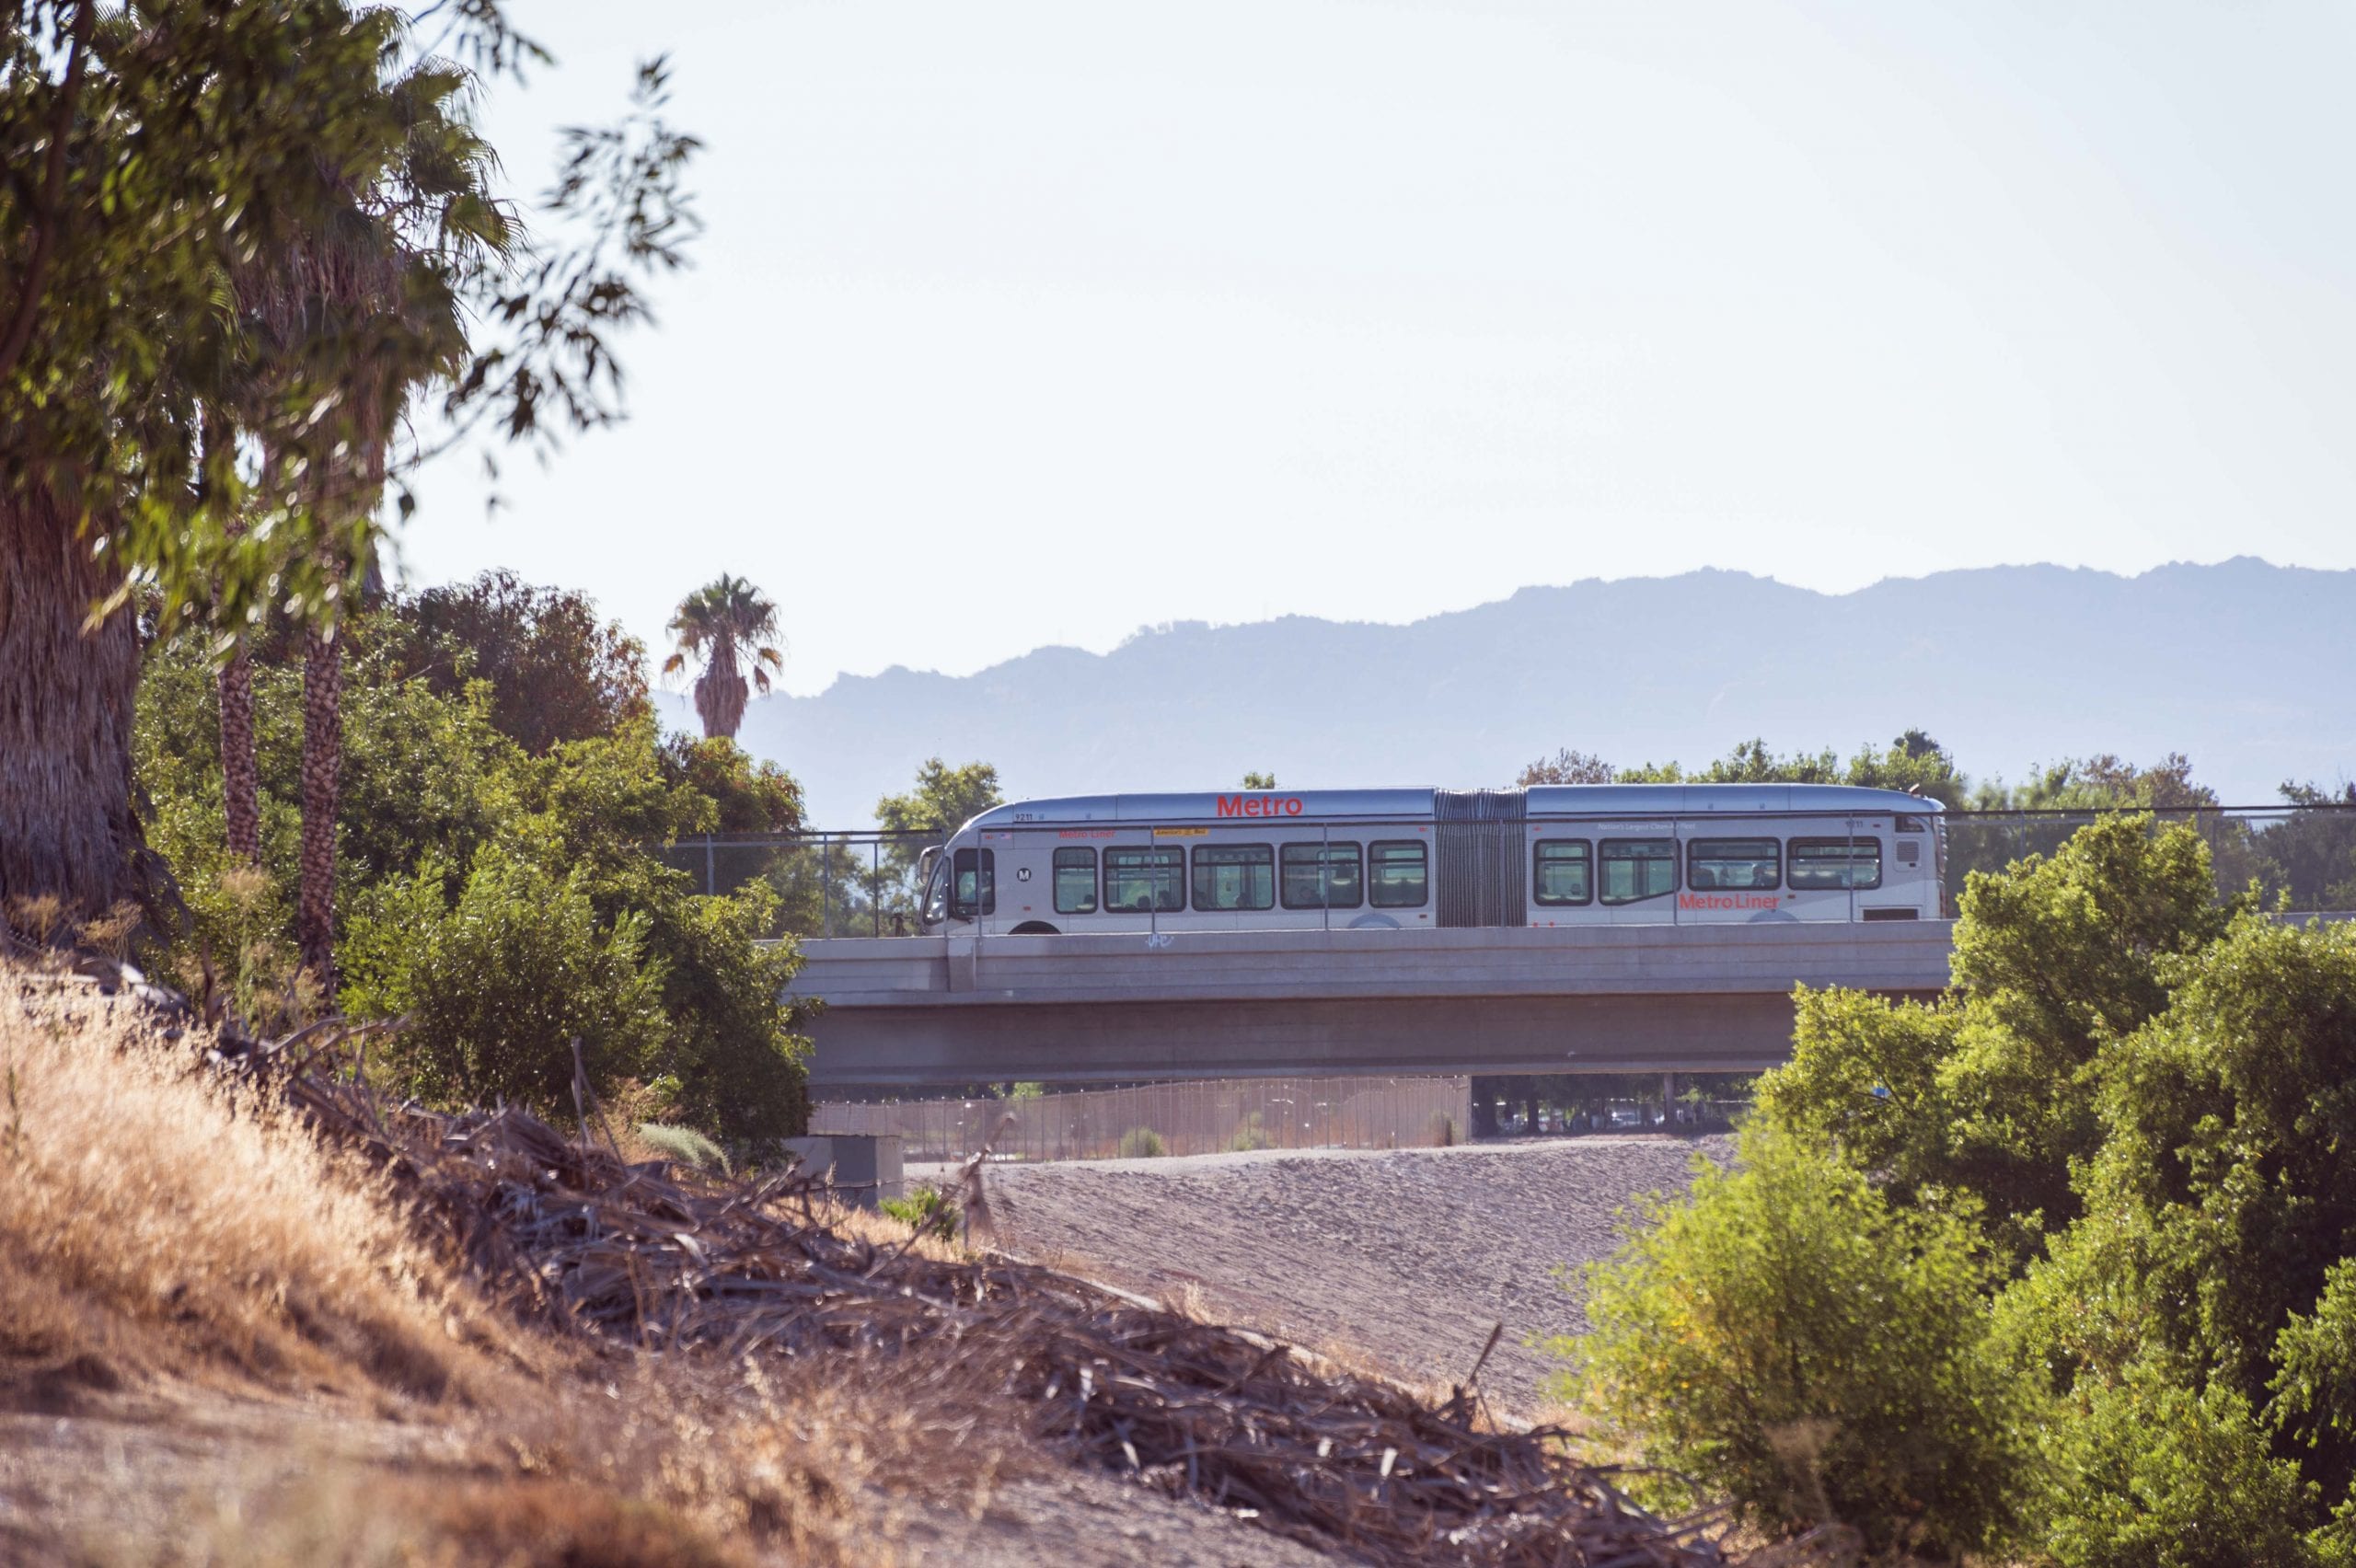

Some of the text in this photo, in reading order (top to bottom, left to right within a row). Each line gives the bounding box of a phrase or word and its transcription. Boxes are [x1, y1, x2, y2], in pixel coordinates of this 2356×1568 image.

[1217, 795, 1303, 817] Metro
[1015, 813, 1033, 822] 9211
[1059, 828, 1115, 839] Metro Liner
[1680, 894, 1781, 909] Metro Liner
